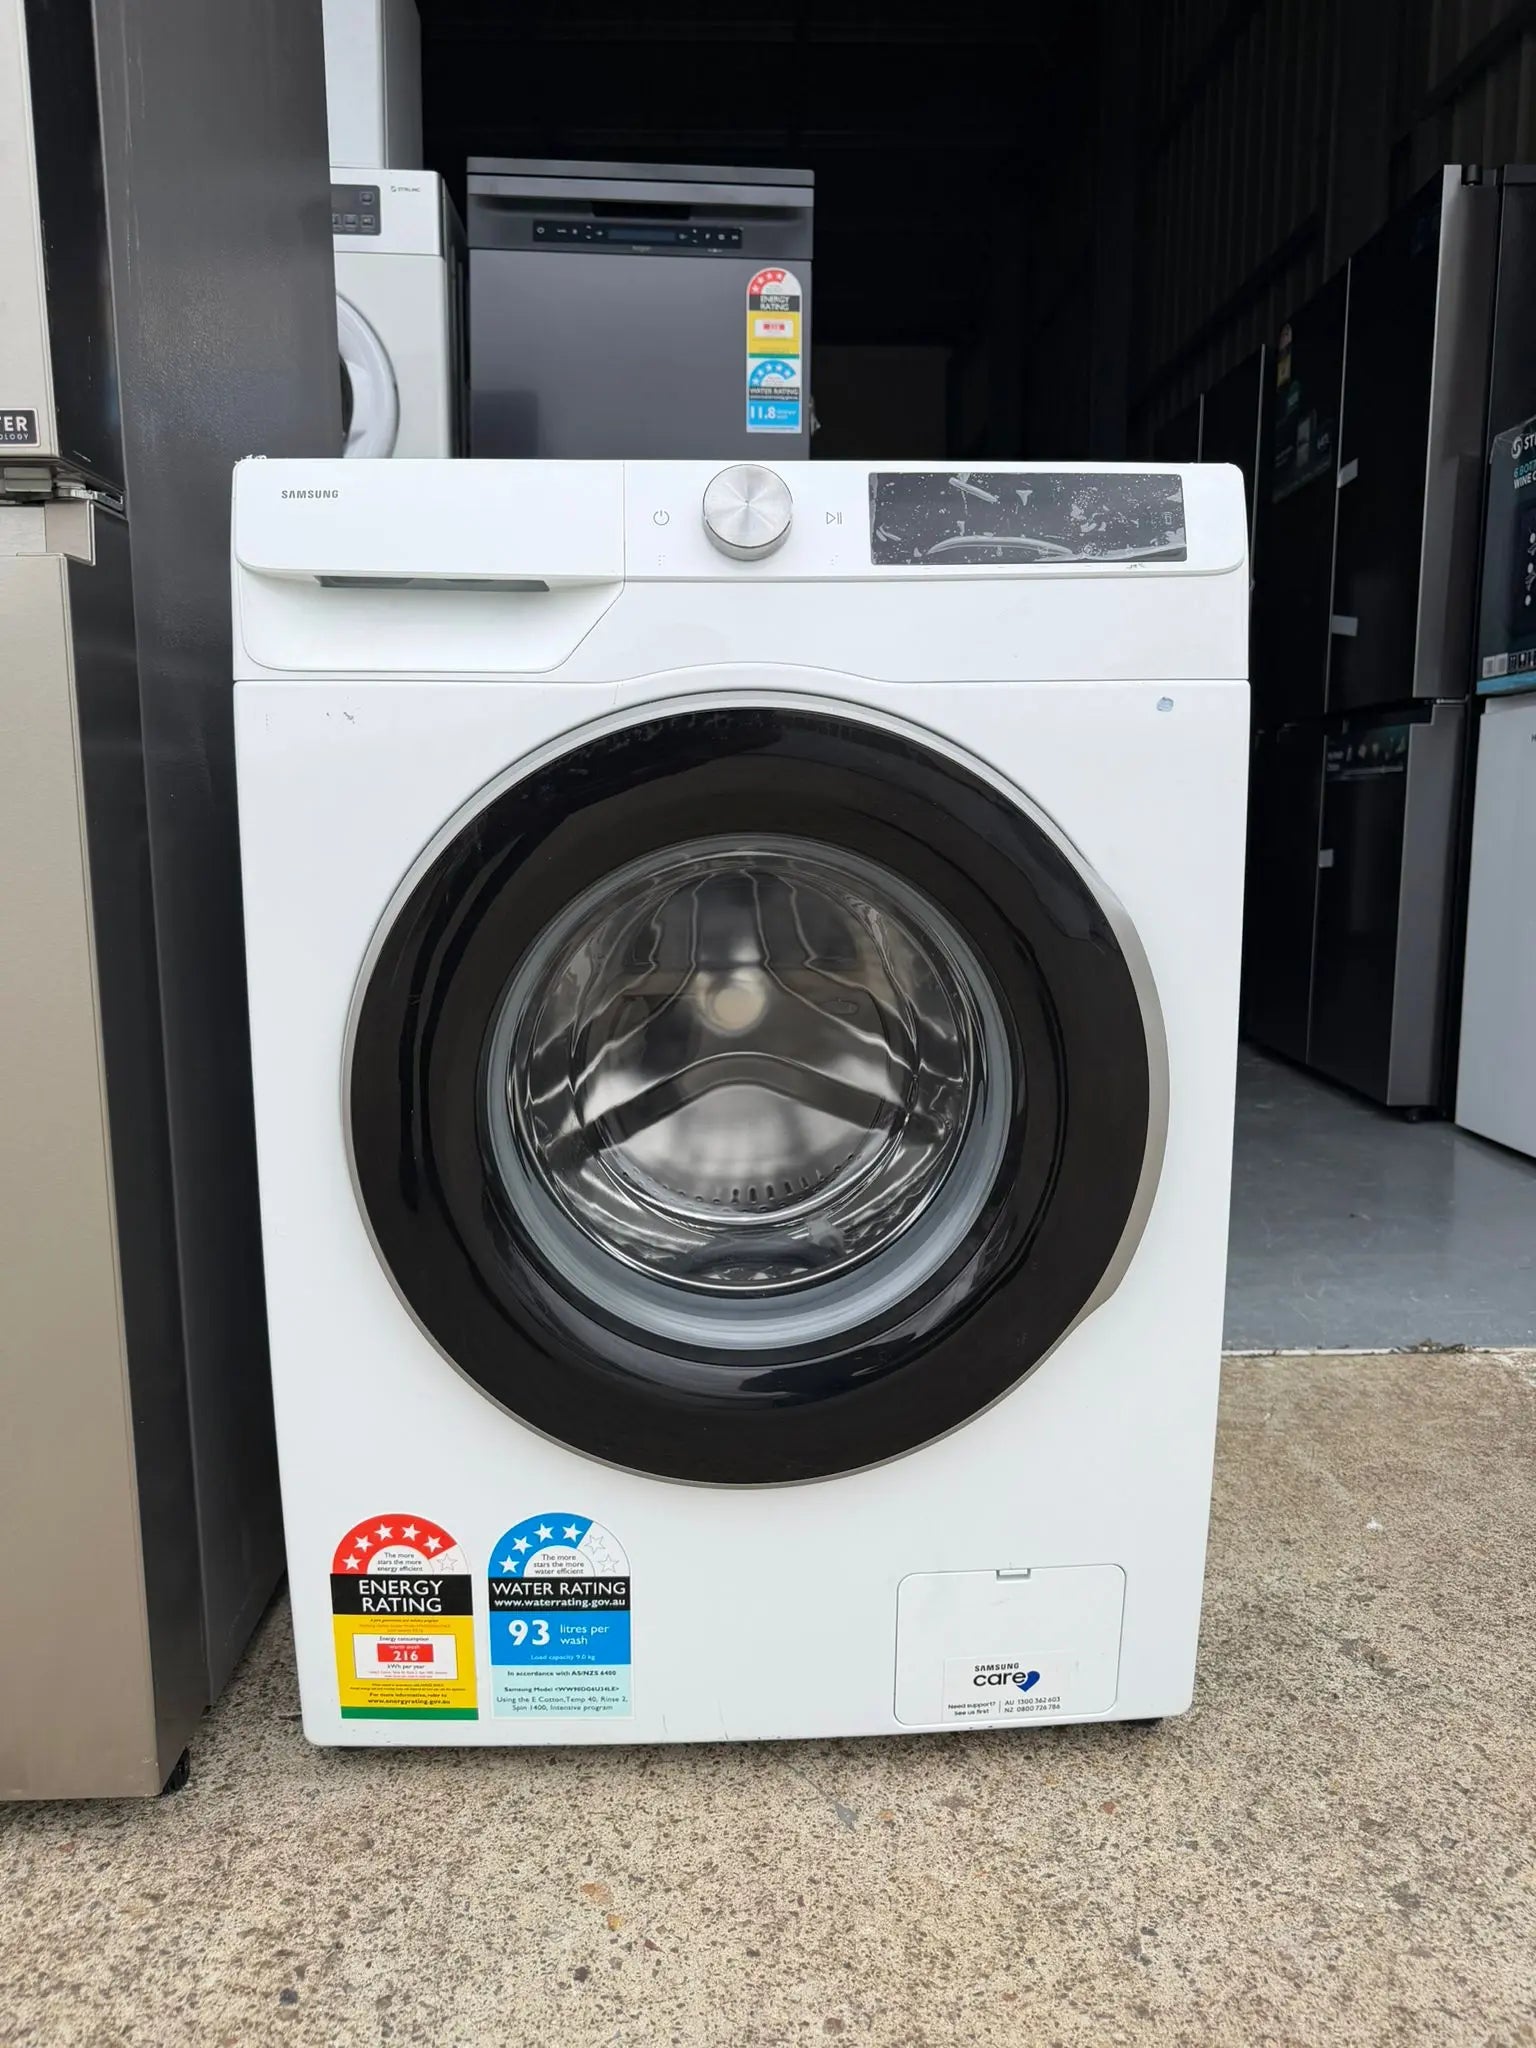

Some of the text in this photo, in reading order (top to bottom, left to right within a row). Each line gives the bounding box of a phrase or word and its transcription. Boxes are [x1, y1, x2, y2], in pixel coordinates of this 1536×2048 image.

[760, 295, 790, 303] ENERGY
[750, 406, 776, 419] 11.8
[281, 490, 339, 498] SAMSUNG
[359, 1580, 443, 1595] ENERGY
[492, 1582, 626, 1595] WATER RATING
[362, 1597, 442, 1612] RATING
[494, 1598, 626, 1608] www.waterrating.gov.au
[508, 1619, 550, 1646] 93
[560, 1624, 609, 1636] litres per
[560, 1636, 588, 1645] wash
[393, 1651, 419, 1661] 216
[974, 1662, 1020, 1672] SAMSUNG
[973, 1672, 1026, 1686] care
